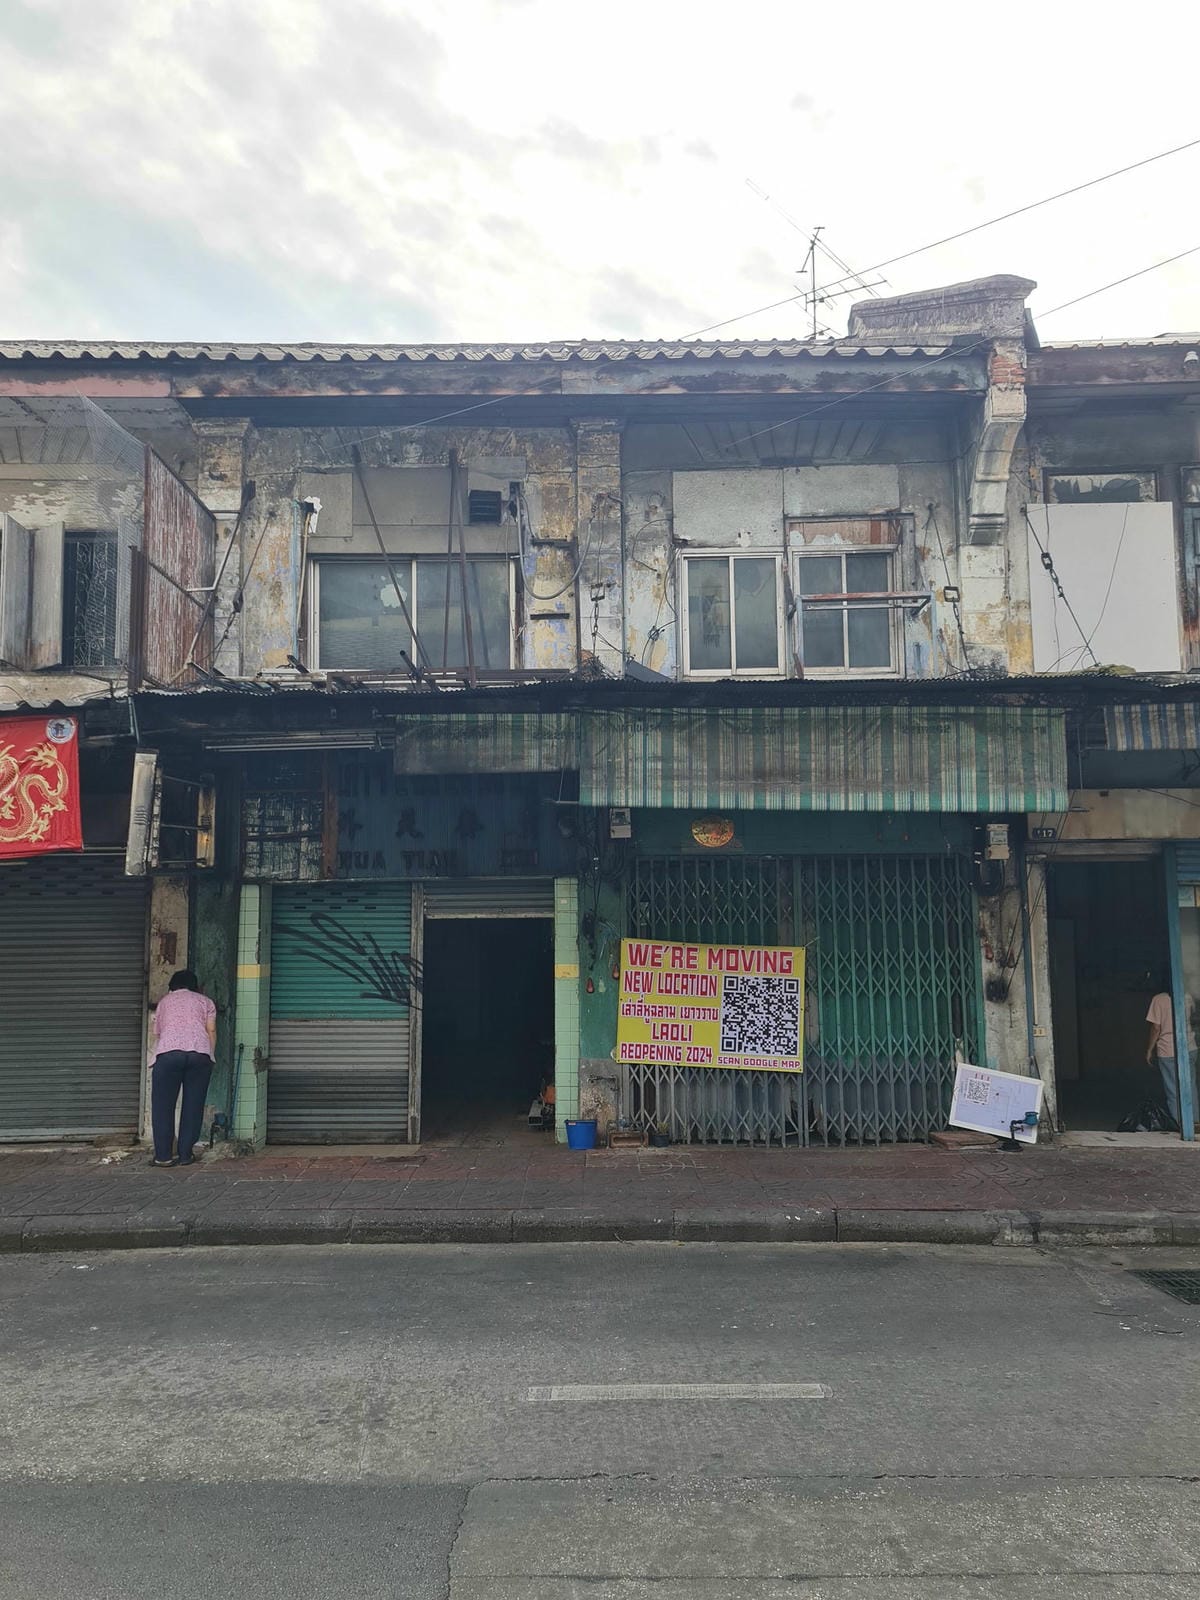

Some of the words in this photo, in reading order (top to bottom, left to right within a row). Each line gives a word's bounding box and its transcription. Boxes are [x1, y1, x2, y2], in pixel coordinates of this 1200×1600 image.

[628, 943, 699, 969] WE'RE
[707, 948, 793, 974] MOVING
[624, 971, 654, 993] NEW
[657, 972, 718, 997] LOCATION
[652, 1023, 693, 1042] LAOLI
[620, 1043, 682, 1061] REOPENING
[686, 1046, 713, 1063] 2024
[717, 1056, 741, 1065] SCAN
[743, 1058, 778, 1067] GOOGLE
[781, 1060, 801, 1068] MAP
